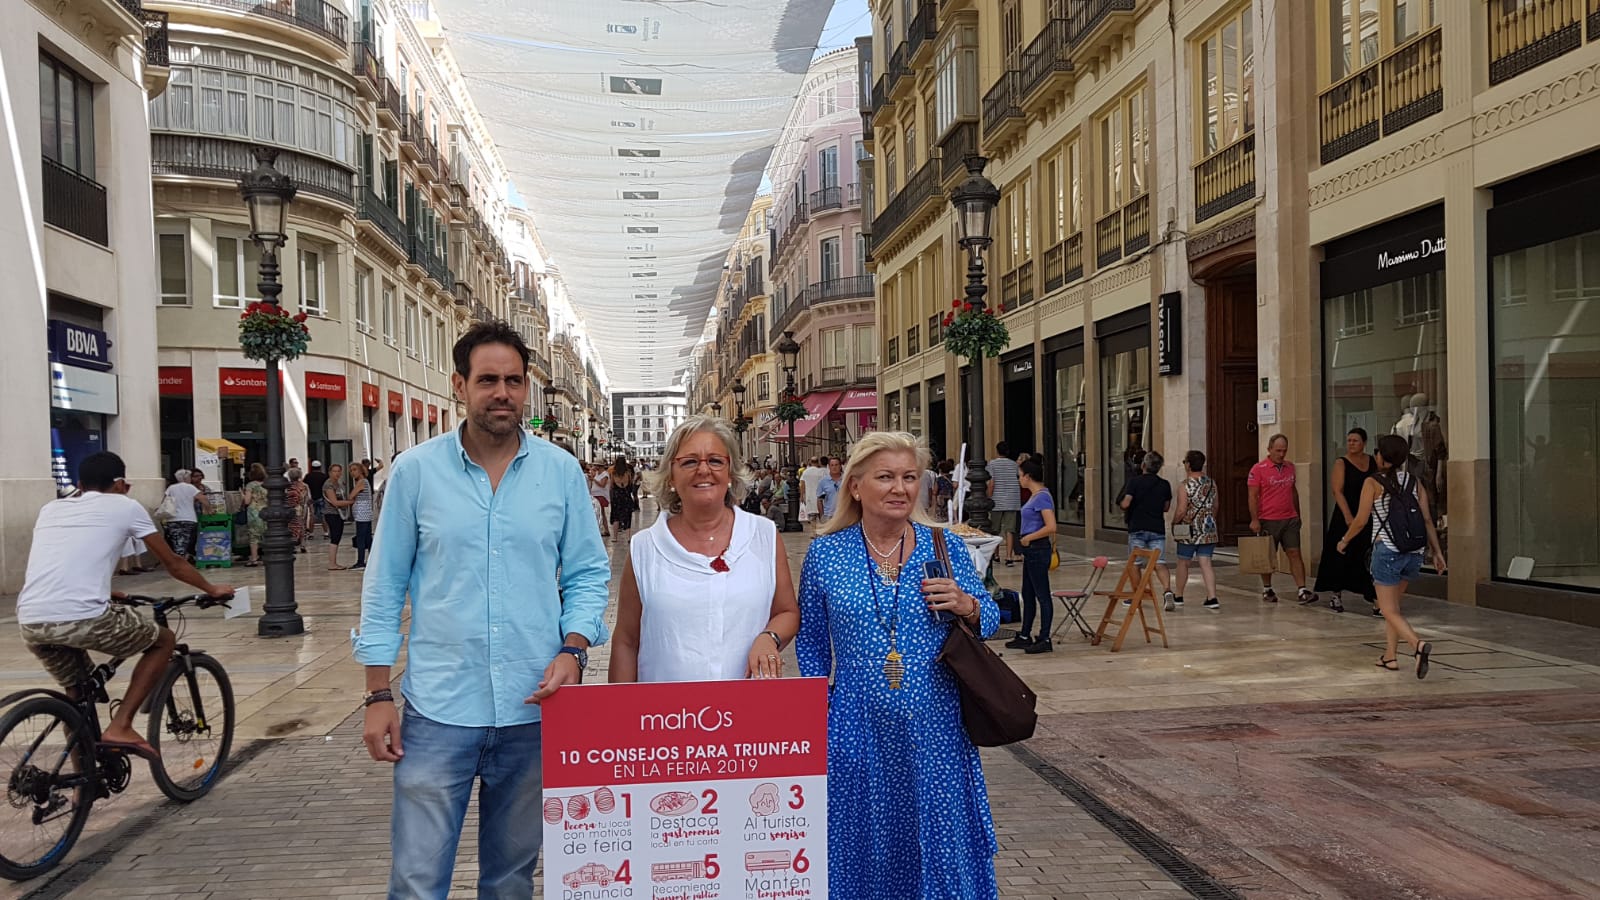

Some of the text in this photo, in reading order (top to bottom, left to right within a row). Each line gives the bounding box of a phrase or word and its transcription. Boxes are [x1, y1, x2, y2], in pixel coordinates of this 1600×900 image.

[1378, 251, 1419, 270] Massimo
[67, 328, 99, 357] BBVA
[560, 740, 810, 765] 10 CONSEJOS PARA TRIUNFAR
[614, 758, 758, 778] EN LA FERIA 2019
[621, 793, 631, 818] 1
[701, 789, 718, 814] 2
[788, 784, 804, 810] 3
[564, 820, 596, 831] Decora
[609, 820, 631, 828] local
[650, 816, 718, 830] Destaca
[744, 815, 810, 830] Al turista,
[563, 828, 632, 840] con motivos
[697, 838, 719, 846] carta
[744, 832, 766, 841] una
[563, 839, 632, 855] de feria
[704, 853, 720, 879] 5
[793, 848, 809, 873] 6
[615, 859, 632, 885] 4
[652, 882, 720, 894] Recomienda
[745, 875, 811, 891] Mantén
[563, 887, 633, 900] Denuncia
